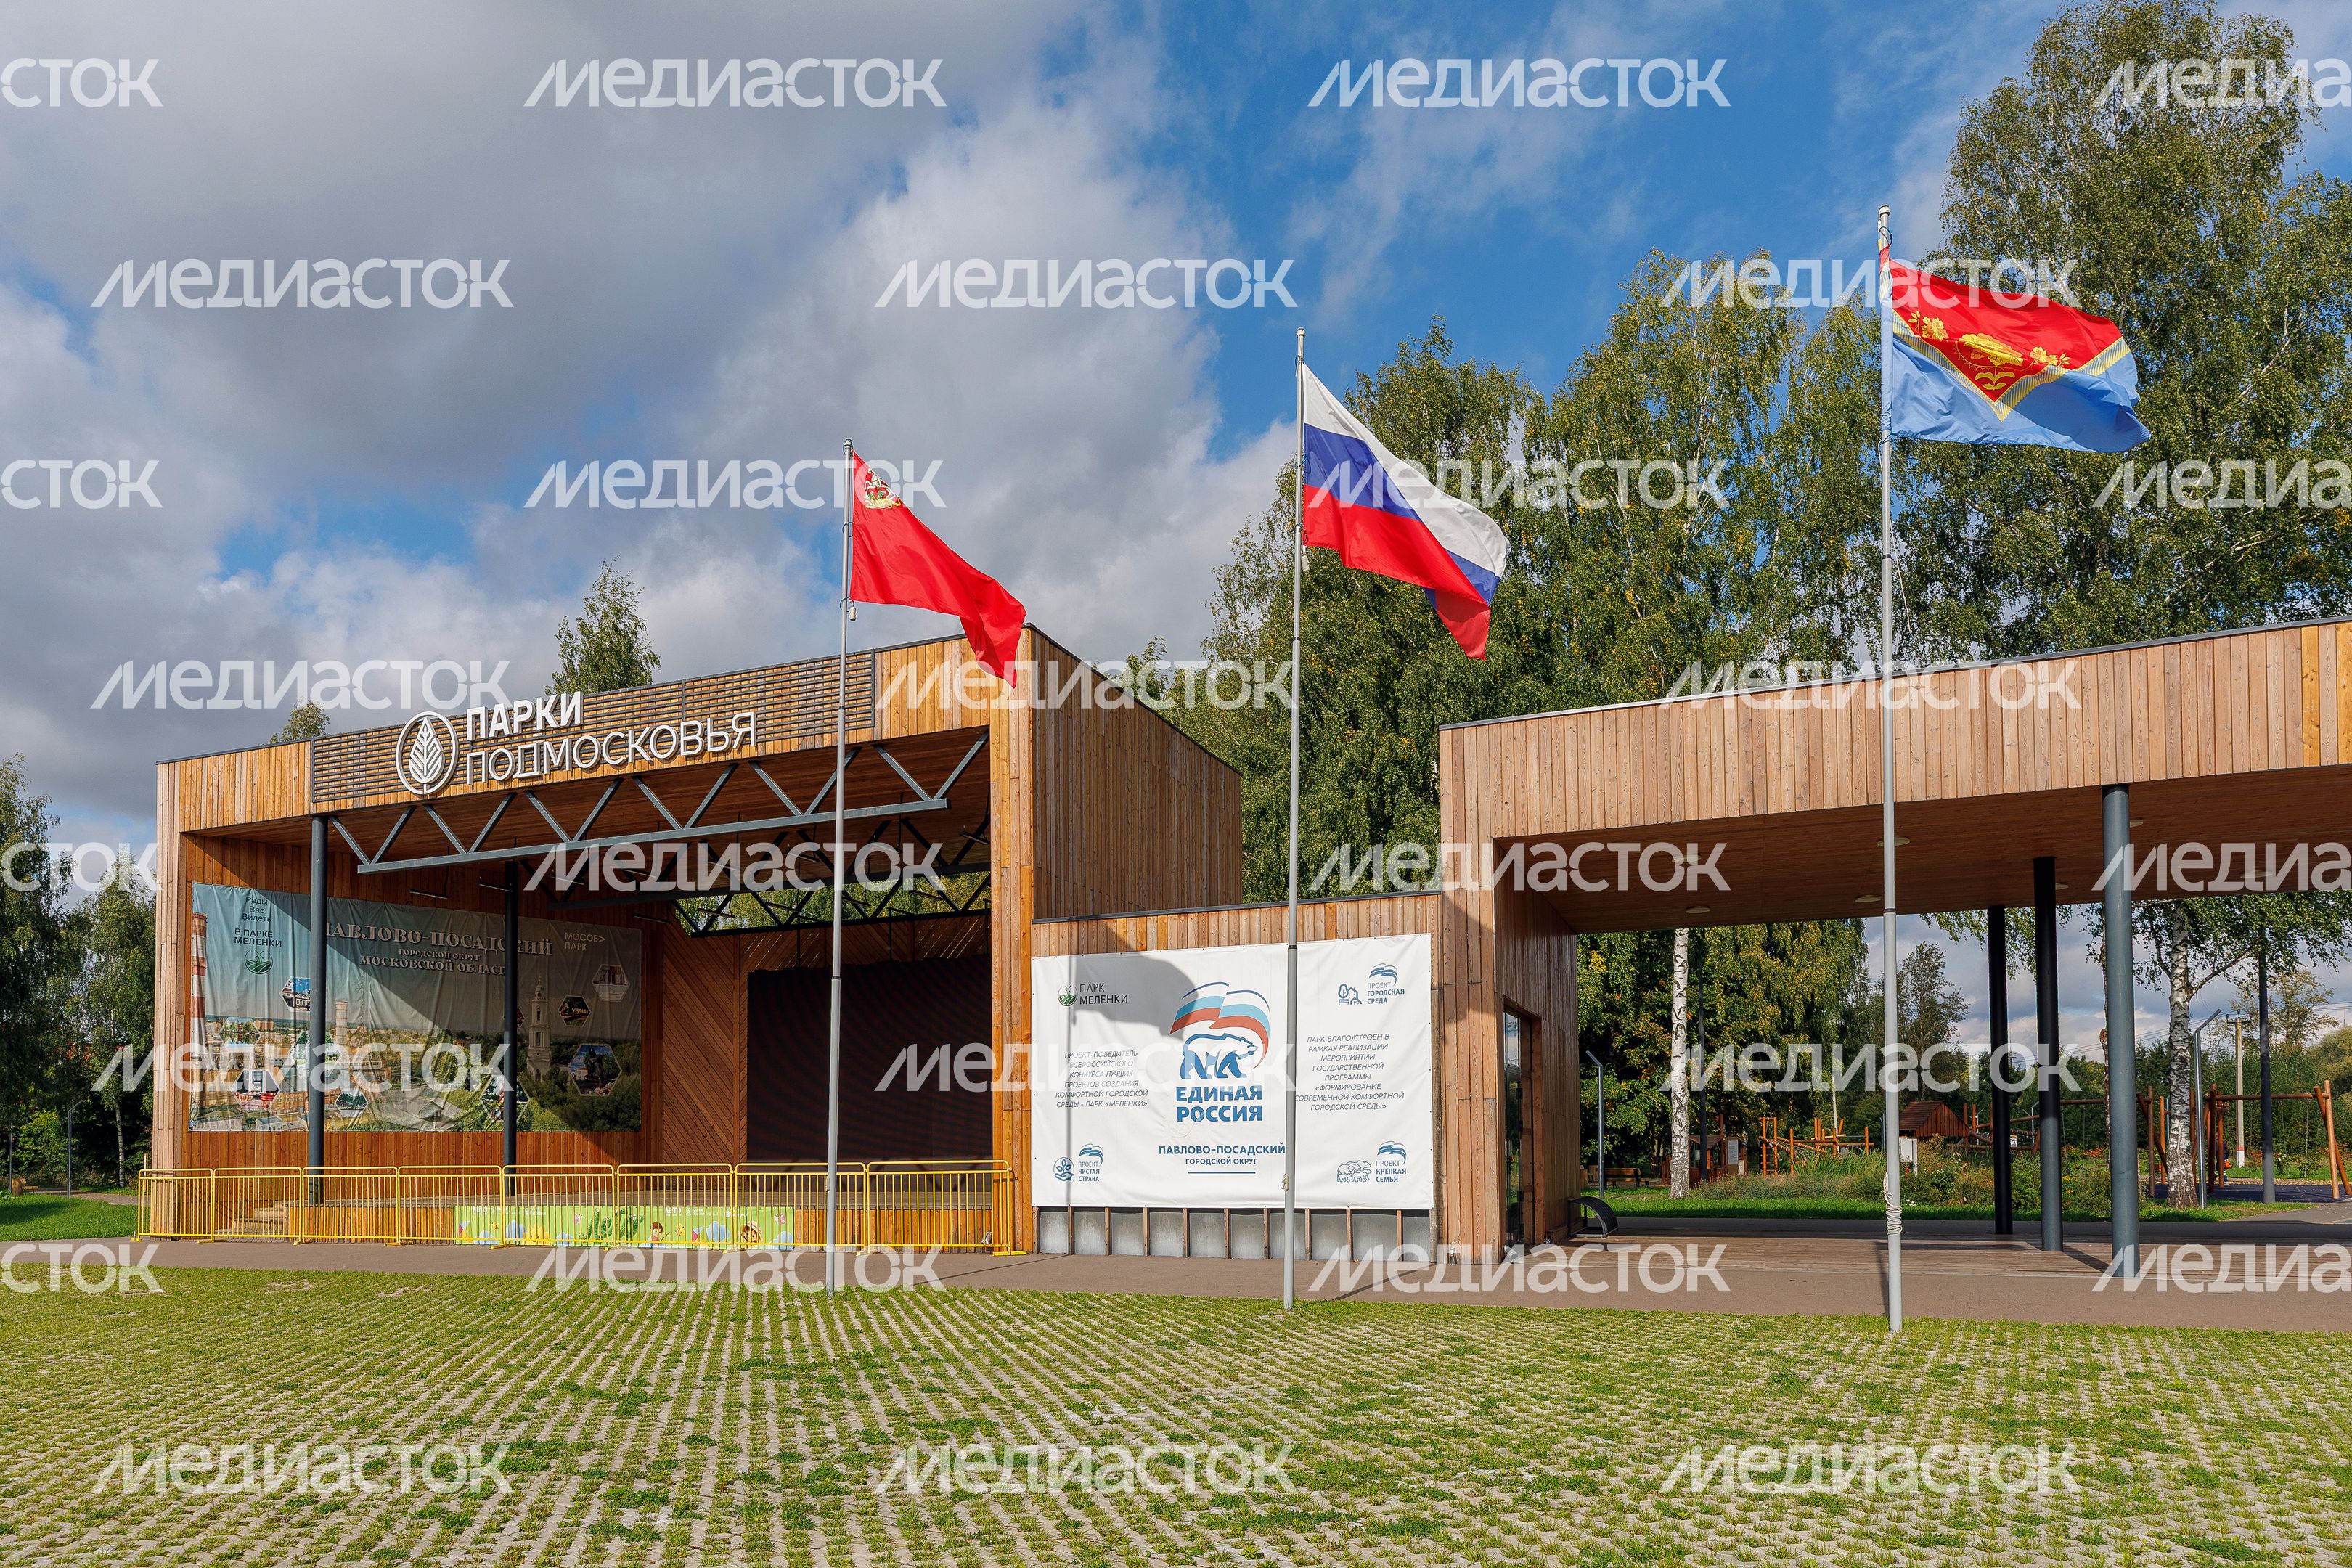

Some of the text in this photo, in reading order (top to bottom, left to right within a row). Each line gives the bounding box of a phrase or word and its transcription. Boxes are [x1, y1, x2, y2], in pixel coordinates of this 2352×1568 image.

[466, 692, 582, 741] ПАРКИ
[466, 711, 757, 785] ПОДМОСКОВЬЯ
[245, 896, 268, 905] Рады
[242, 913, 271, 923] Видеть
[243, 929, 273, 938] ПАРКЕ
[234, 936, 282, 947] МЕЛЕНКИ
[565, 942, 587, 951] ПАРК
[399, 948, 481, 961] ГОРОДСКОЙ ОКРУГ
[360, 955, 454, 972] МОСКОВСКОЙ
[1079, 983, 1105, 992] ПАРК
[1079, 994, 1128, 1005] МЕЛЕНКИ
[1327, 1034, 1383, 1042] БЛАГОУСТРОЕН
[1320, 1053, 1376, 1061] МЕРОПРИЯТИЙ
[1069, 1059, 1133, 1068] ВСЕРОССИЙСКОГО
[1312, 1062, 1384, 1071] ГОСУДАРСТВЕННОЙ
[1105, 1088, 1148, 1097] ГОРОДСКОЙ
[1176, 1085, 1262, 1103] ЕДИНАЯ
[1295, 1091, 1404, 1101] СОВРЕМЕННОЙ КОМФОРТНОЙ
[1311, 1102, 1355, 1111] ГОРОДСКОЙ
[1177, 1105, 1262, 1122] РОССИЯ
[1159, 1142, 1286, 1156] ПАВЛОВО-ПОСАДСКИЙ
[1185, 1156, 1231, 1165] ГОРОДСКОЙ
